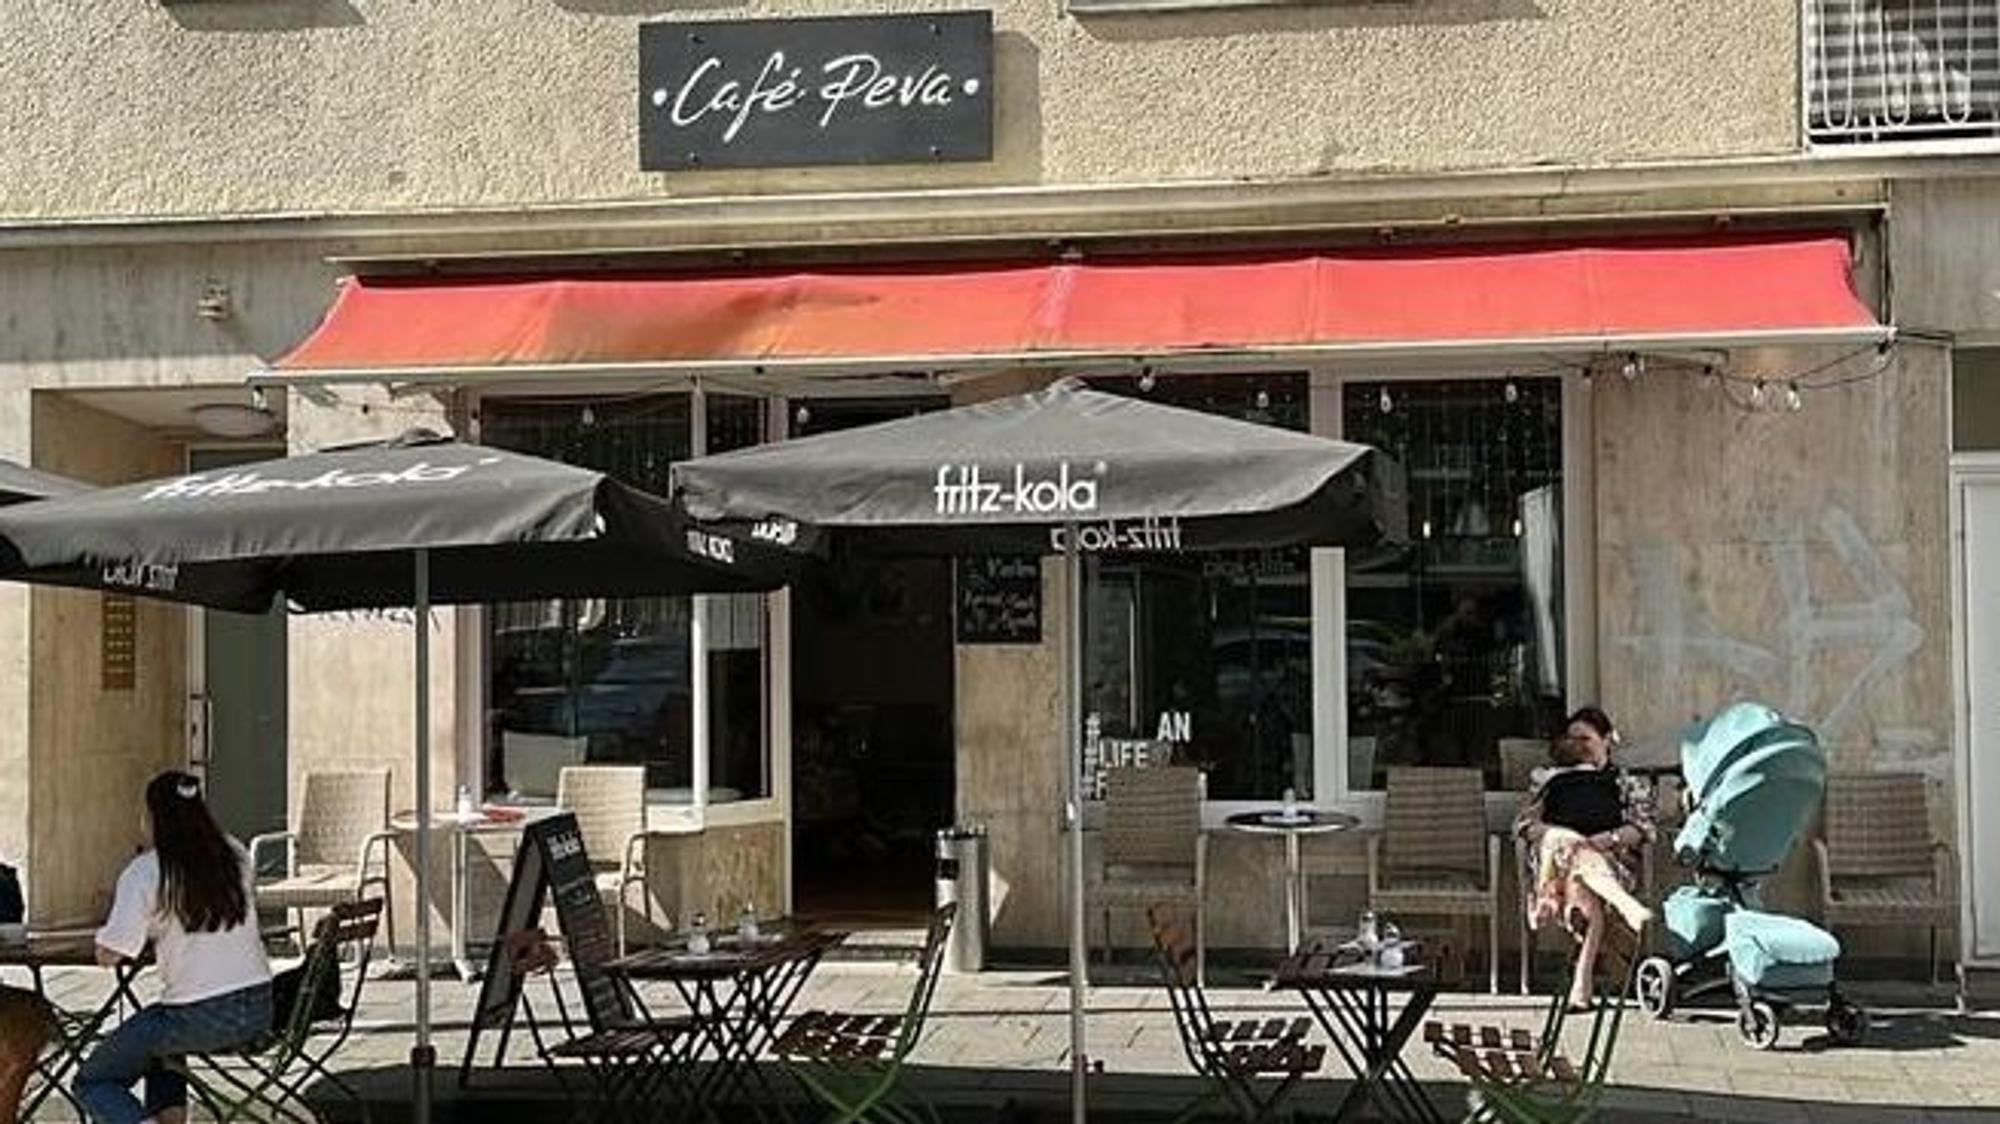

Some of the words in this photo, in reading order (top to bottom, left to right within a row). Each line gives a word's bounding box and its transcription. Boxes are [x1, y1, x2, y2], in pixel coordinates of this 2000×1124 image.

[670, 51, 801, 144] Café
[820, 53, 953, 127] Peva
[934, 462, 1098, 514] fritz-kola
